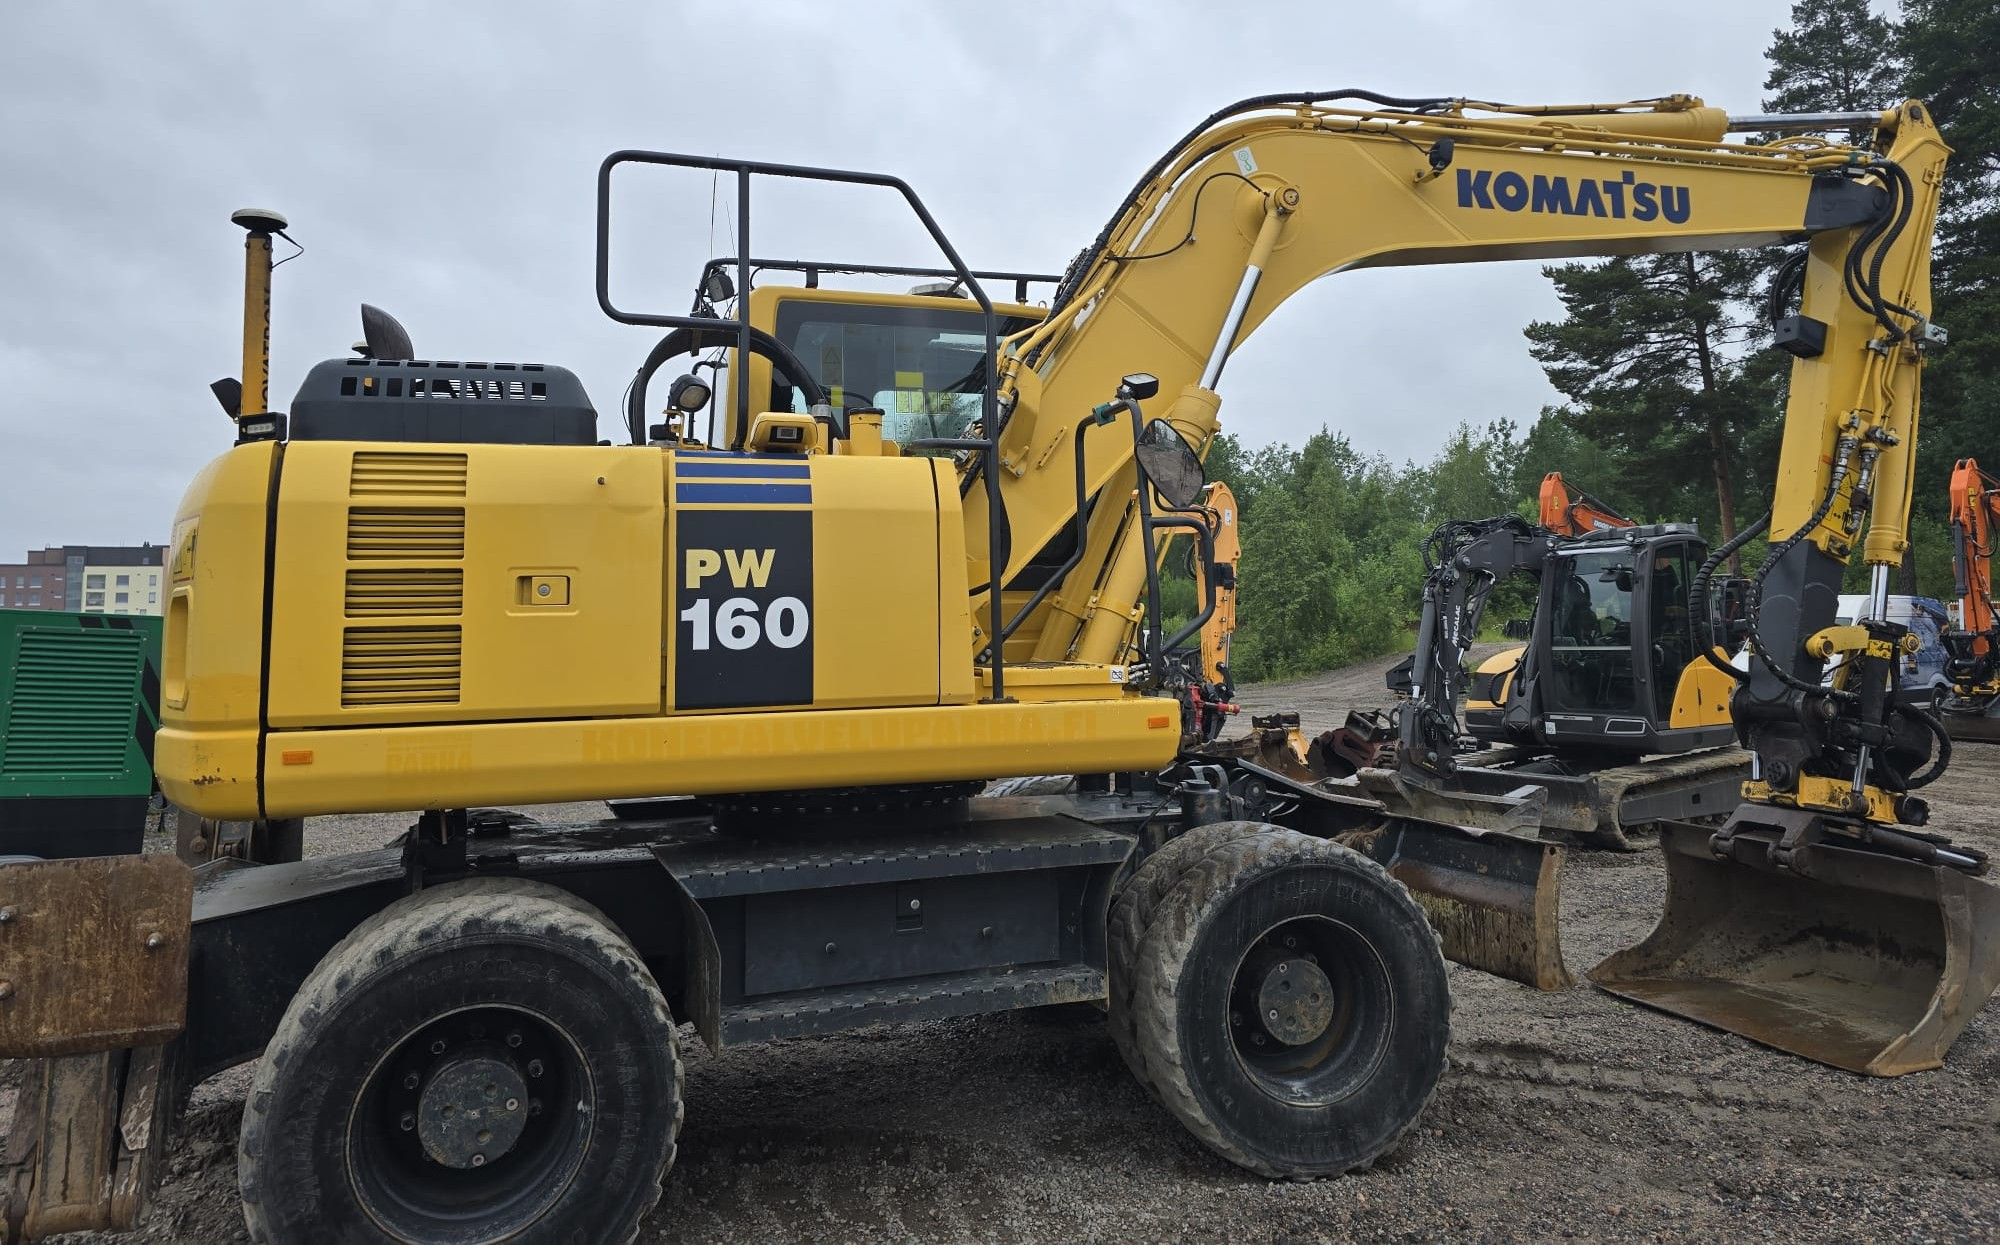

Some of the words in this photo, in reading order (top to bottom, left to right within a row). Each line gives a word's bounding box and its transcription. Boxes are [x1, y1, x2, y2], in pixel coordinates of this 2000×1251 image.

[1456, 168, 1692, 224] KOMATSU
[685, 548, 776, 589] PW
[681, 596, 809, 651] 160
